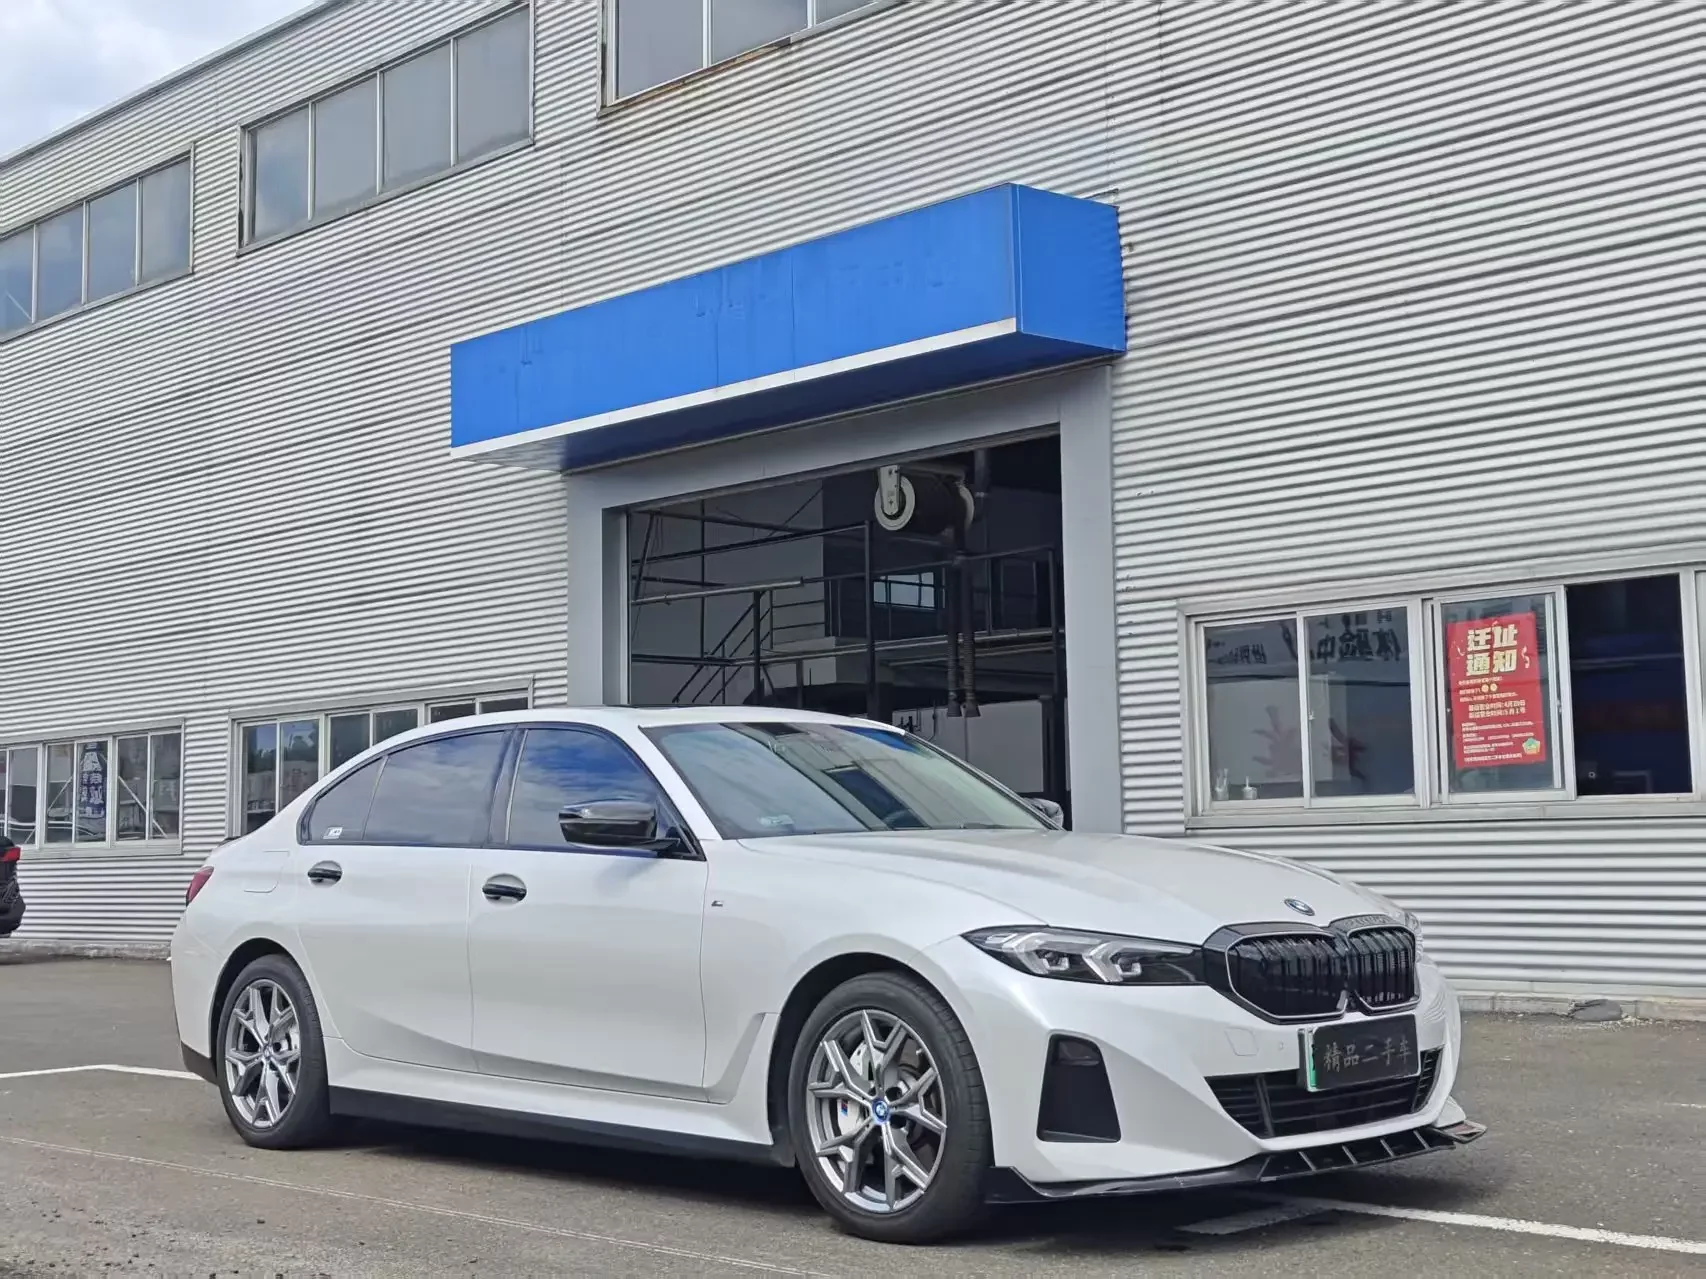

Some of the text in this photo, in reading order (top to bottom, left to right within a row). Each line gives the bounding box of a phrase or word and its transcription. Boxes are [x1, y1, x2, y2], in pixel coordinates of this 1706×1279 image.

[1466, 649, 1517, 676] 通知
[1324, 1035, 1412, 1072] 精品二手车
